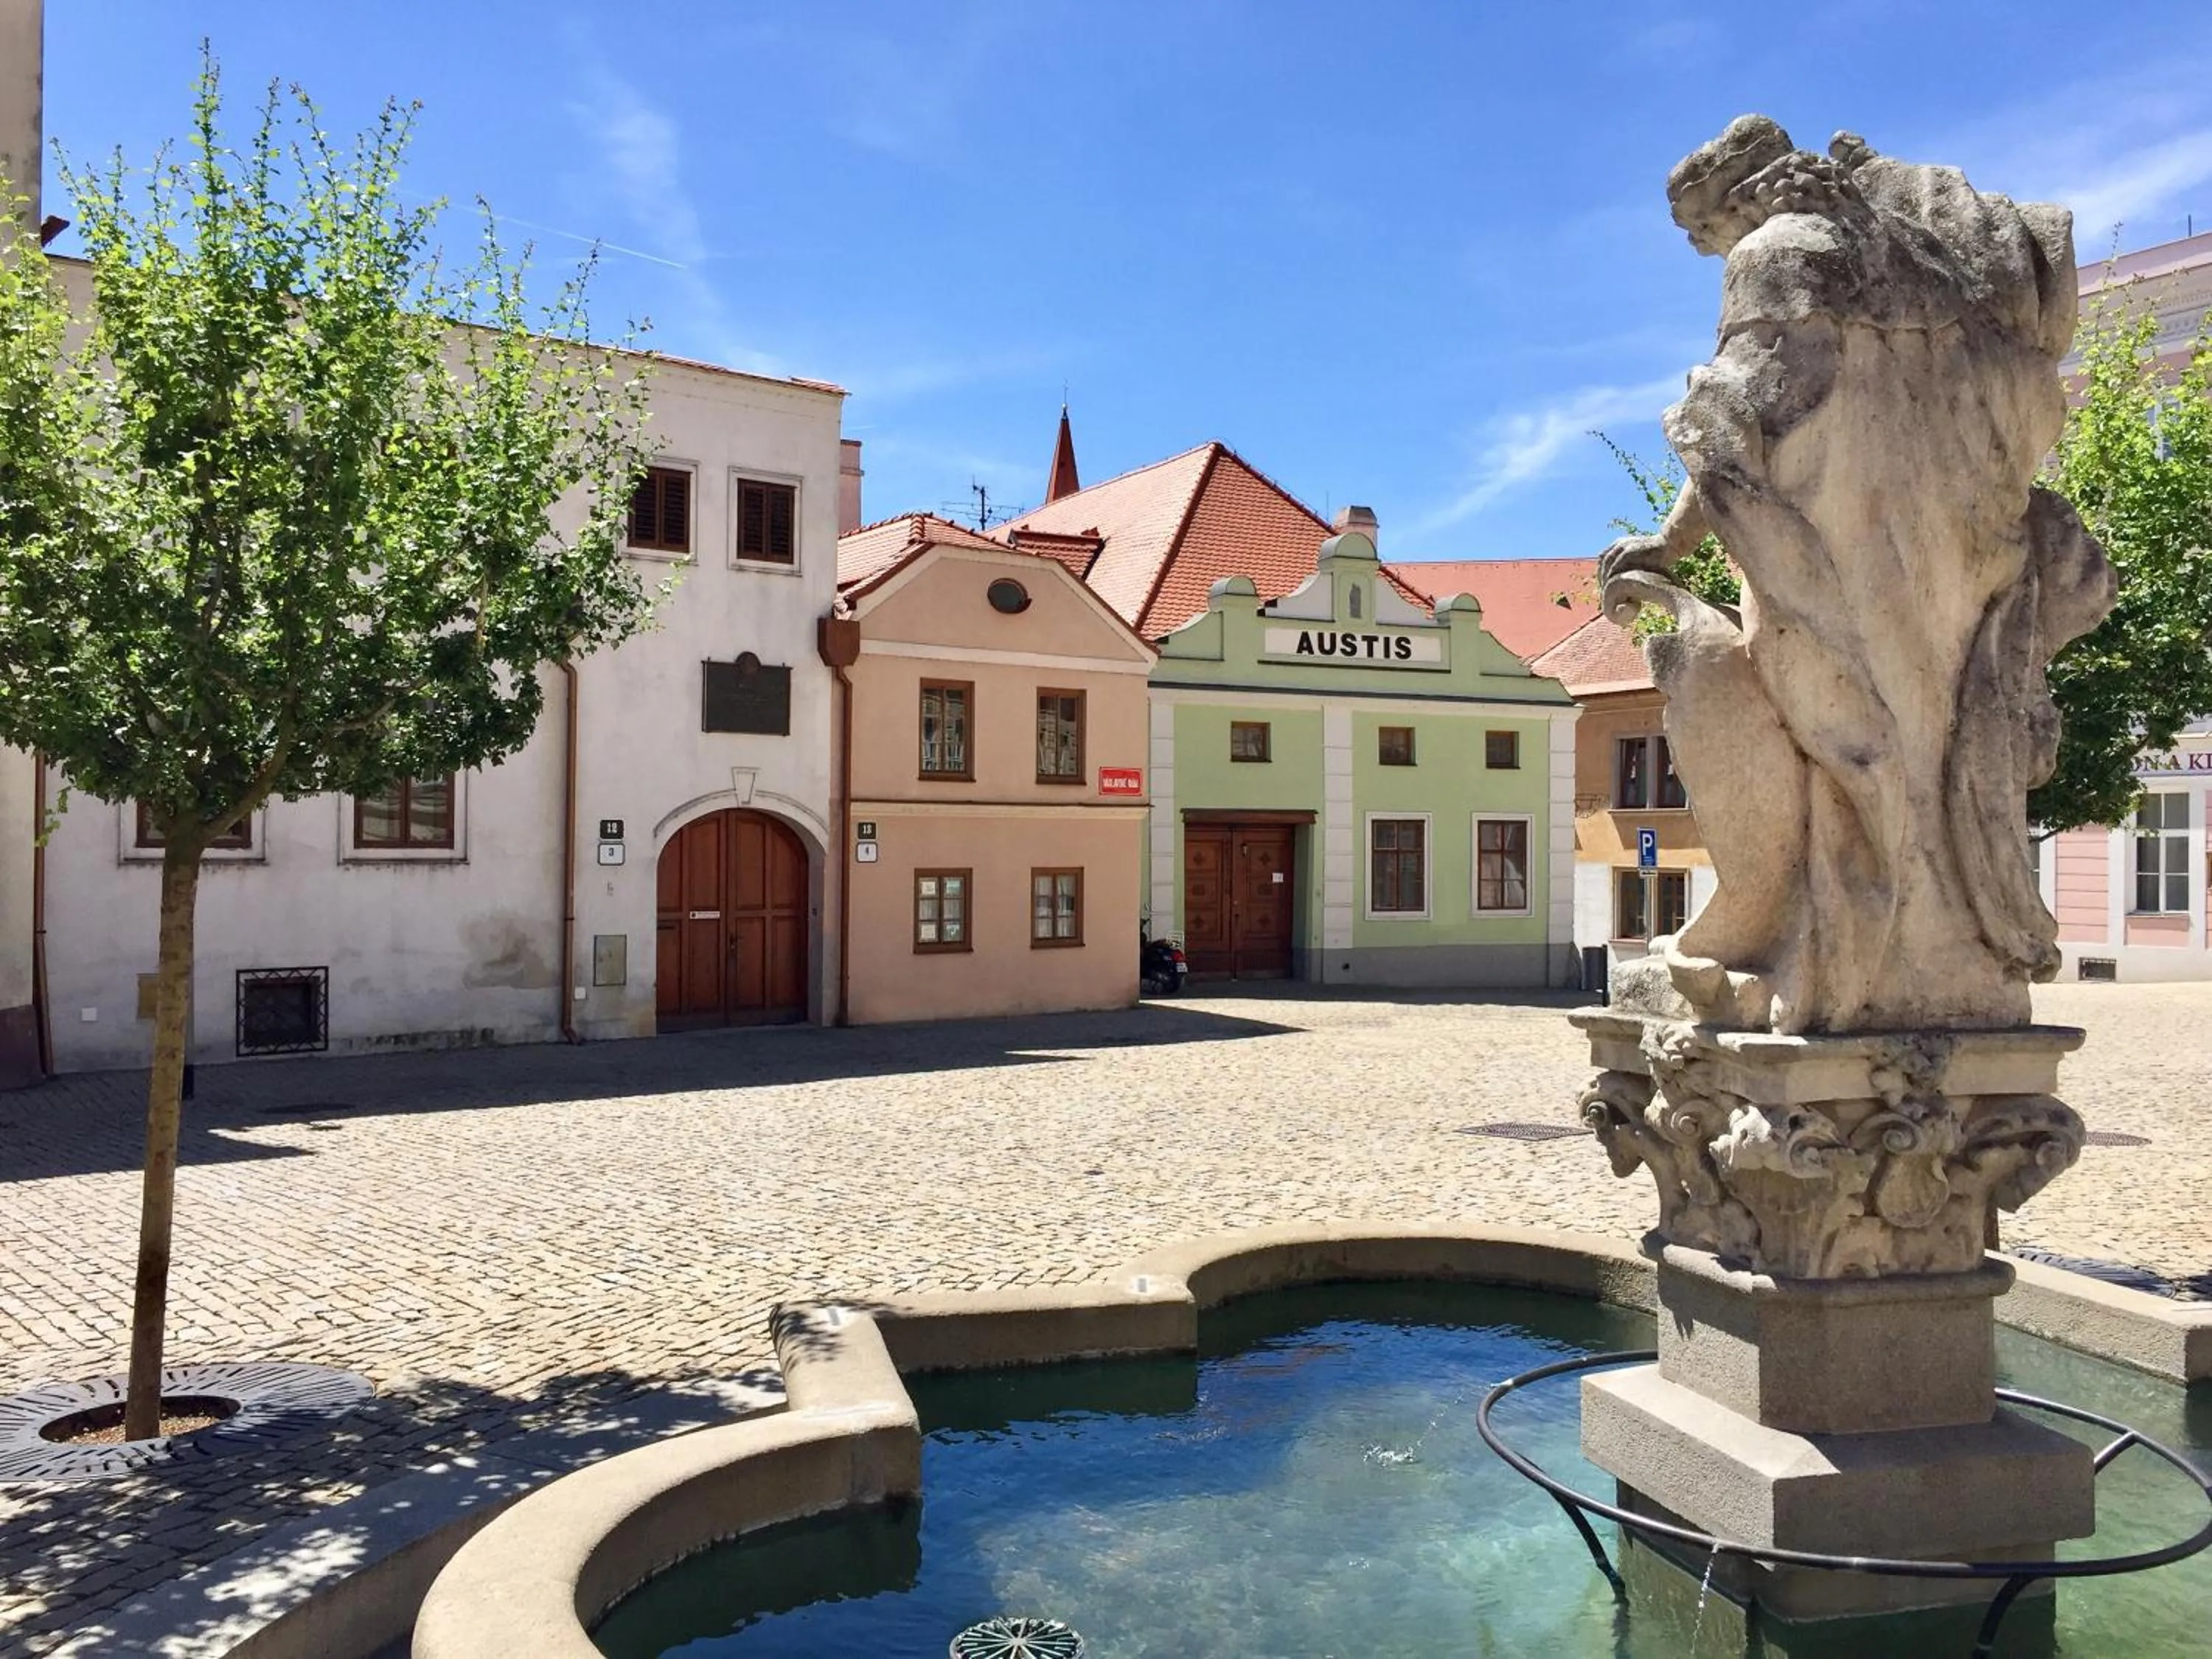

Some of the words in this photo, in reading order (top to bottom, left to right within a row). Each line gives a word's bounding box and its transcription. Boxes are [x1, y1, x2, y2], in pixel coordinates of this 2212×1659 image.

[1295, 631, 1412, 660] AUSTIS
[608, 847, 614, 857] 3
[1642, 833, 1653, 856] P
